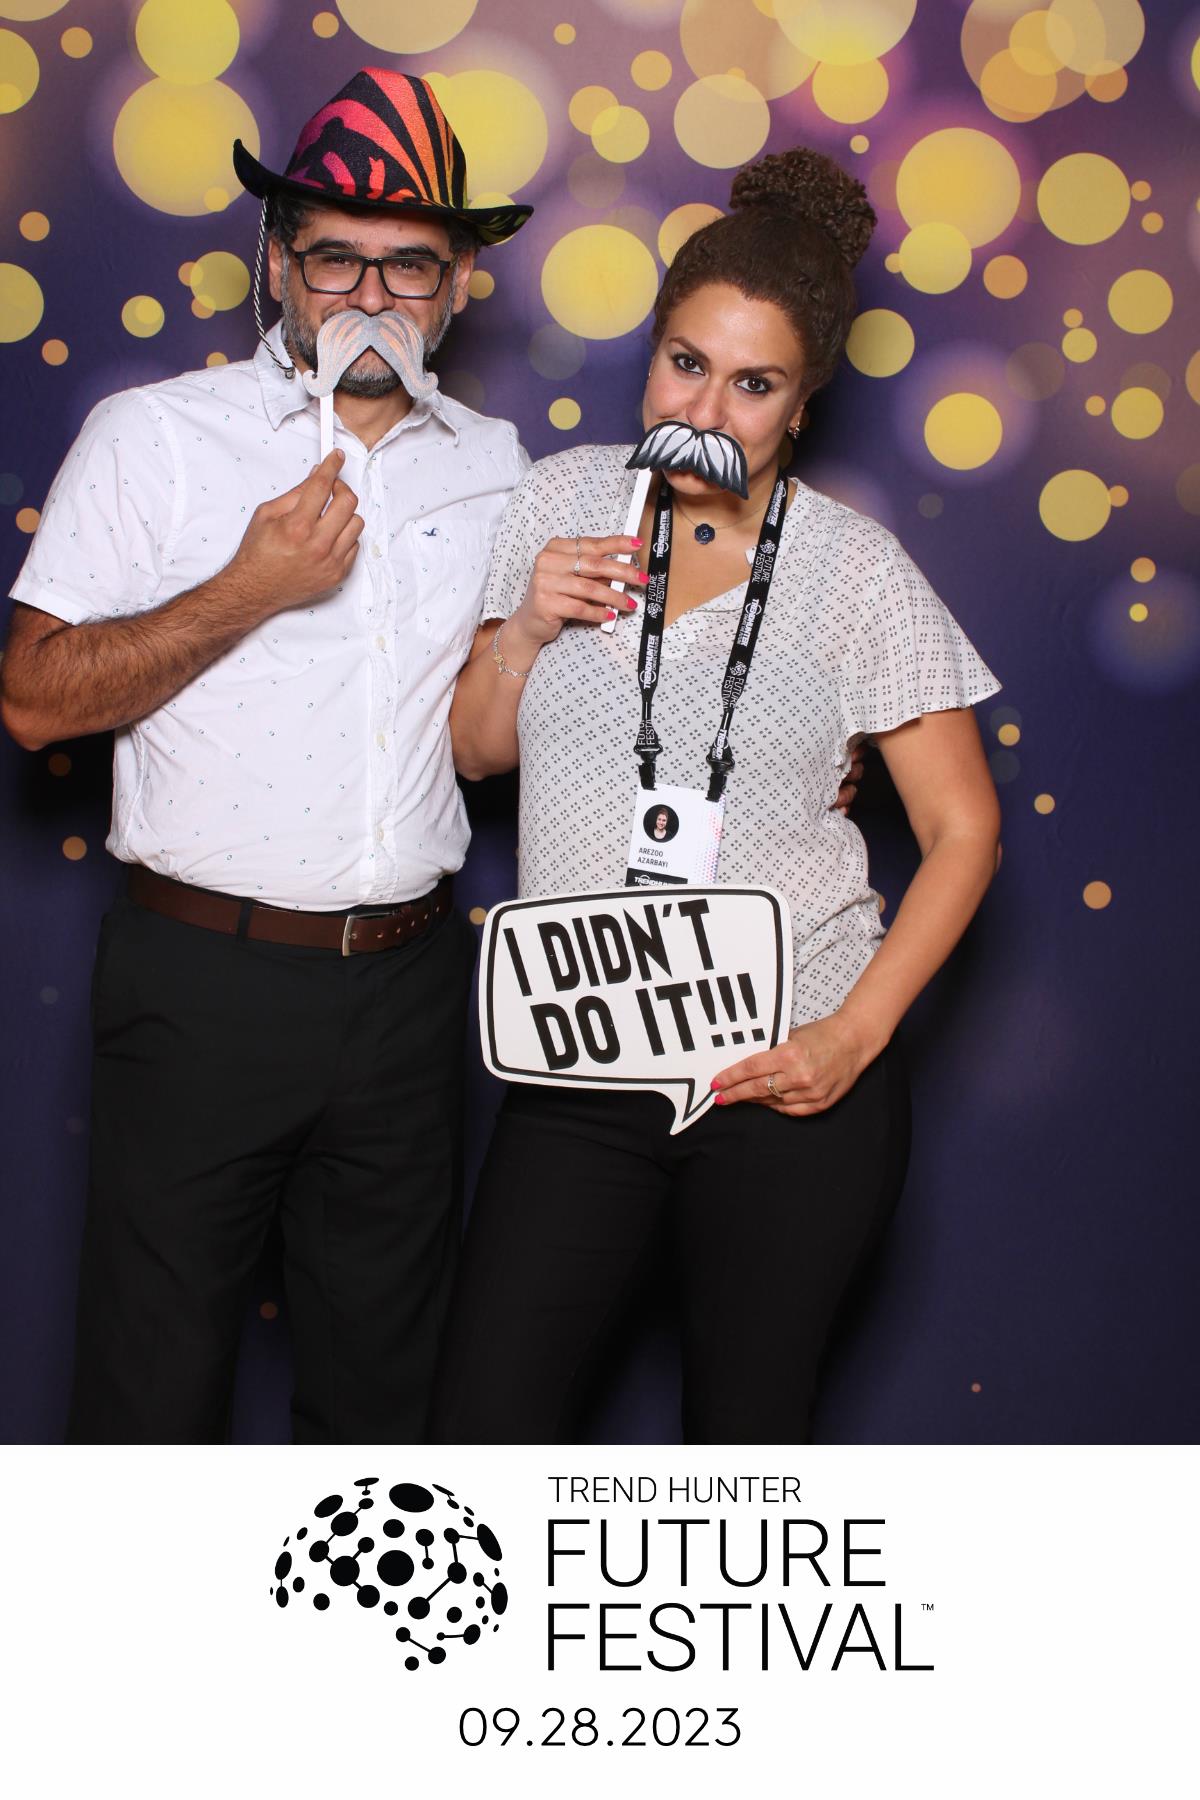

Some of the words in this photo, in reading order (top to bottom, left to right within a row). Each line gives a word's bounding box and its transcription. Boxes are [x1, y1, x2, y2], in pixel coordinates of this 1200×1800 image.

[656, 509, 668, 558] TRENDHUNTER
[648, 573, 658, 601] FUTURE
[656, 571, 667, 603] FESTIVAL
[752, 552, 766, 584] FESTIVAL
[761, 555, 774, 583] FUTURE
[741, 598, 759, 647] TRENDHUNTER
[643, 633, 657, 689] TRENDHUNTER
[638, 847, 664, 857] AREZOO
[504, 928, 532, 996] I
[538, 899, 713, 991] DIDN'T
[530, 996, 620, 1070] DO
[636, 973, 765, 1056] IT!!!
